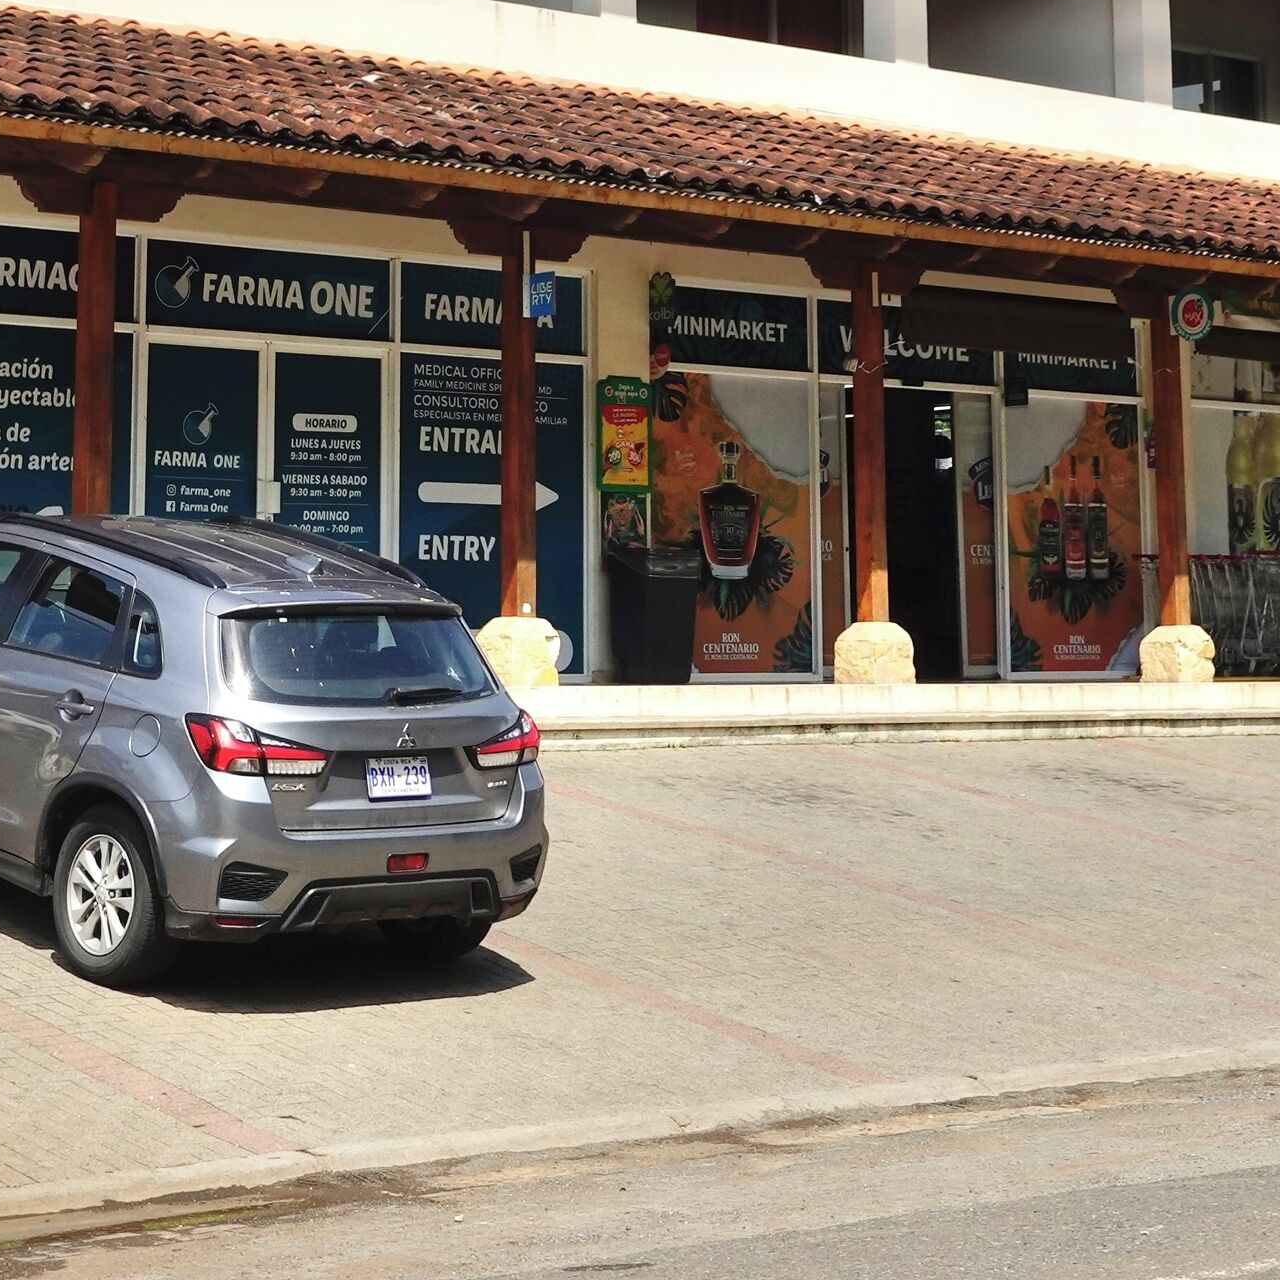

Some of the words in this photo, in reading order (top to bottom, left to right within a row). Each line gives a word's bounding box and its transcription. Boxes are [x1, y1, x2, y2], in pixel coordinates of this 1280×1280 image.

[202, 272, 305, 311] FARMA
[310, 280, 375, 318] ONE
[532, 293, 552, 306] RTY
[667, 314, 789, 344] MINIMARKET
[839, 325, 970, 362] WLCOME
[413, 363, 468, 378] MEDICAL
[470, 367, 502, 380] OFFIC
[413, 378, 444, 389] FAMILY
[445, 380, 487, 391] MEDICINE
[538, 386, 552, 395] MD
[413, 394, 499, 410] CONSULTORIO
[305, 417, 347, 429] HORARIO
[413, 409, 471, 421] ESPECIALISTA
[473, 412, 485, 421] EN
[535, 416, 568, 425] AMILIAR
[6, 422, 31, 443] de
[291, 438, 320, 449] LUNES
[321, 439, 328, 449] A
[328, 439, 362, 450] JUEVES
[419, 425, 502, 455] ENTRA
[27, 452, 74, 472] arte
[154, 450, 207, 468] FARMA
[213, 454, 240, 469] ONE
[290, 451, 309, 461] 9:30
[309, 453, 322, 461] am
[329, 452, 348, 462] 8:00
[349, 454, 362, 463] pm
[282, 473, 321, 485] VIERNES
[322, 475, 329, 485] A
[330, 475, 368, 486] SABADO
[180, 485, 232, 498] farma_one
[290, 487, 309, 497] 9:30
[309, 489, 322, 497] am
[329, 488, 348, 497] 9:00
[349, 490, 362, 499] pm
[180, 501, 209, 512] Farma
[210, 503, 229, 513] One
[303, 510, 350, 521] DOMINGO
[312, 525, 325, 533] am
[331, 524, 350, 533] 7:00
[351, 525, 364, 534] pm
[418, 534, 496, 562] ENTRY
[722, 632, 740, 643] RON
[1069, 635, 1085, 644] RON
[703, 643, 759, 654] CENTENARIO
[1053, 644, 1101, 654] CENTENARIO
[370, 765, 427, 787] BXH-239
